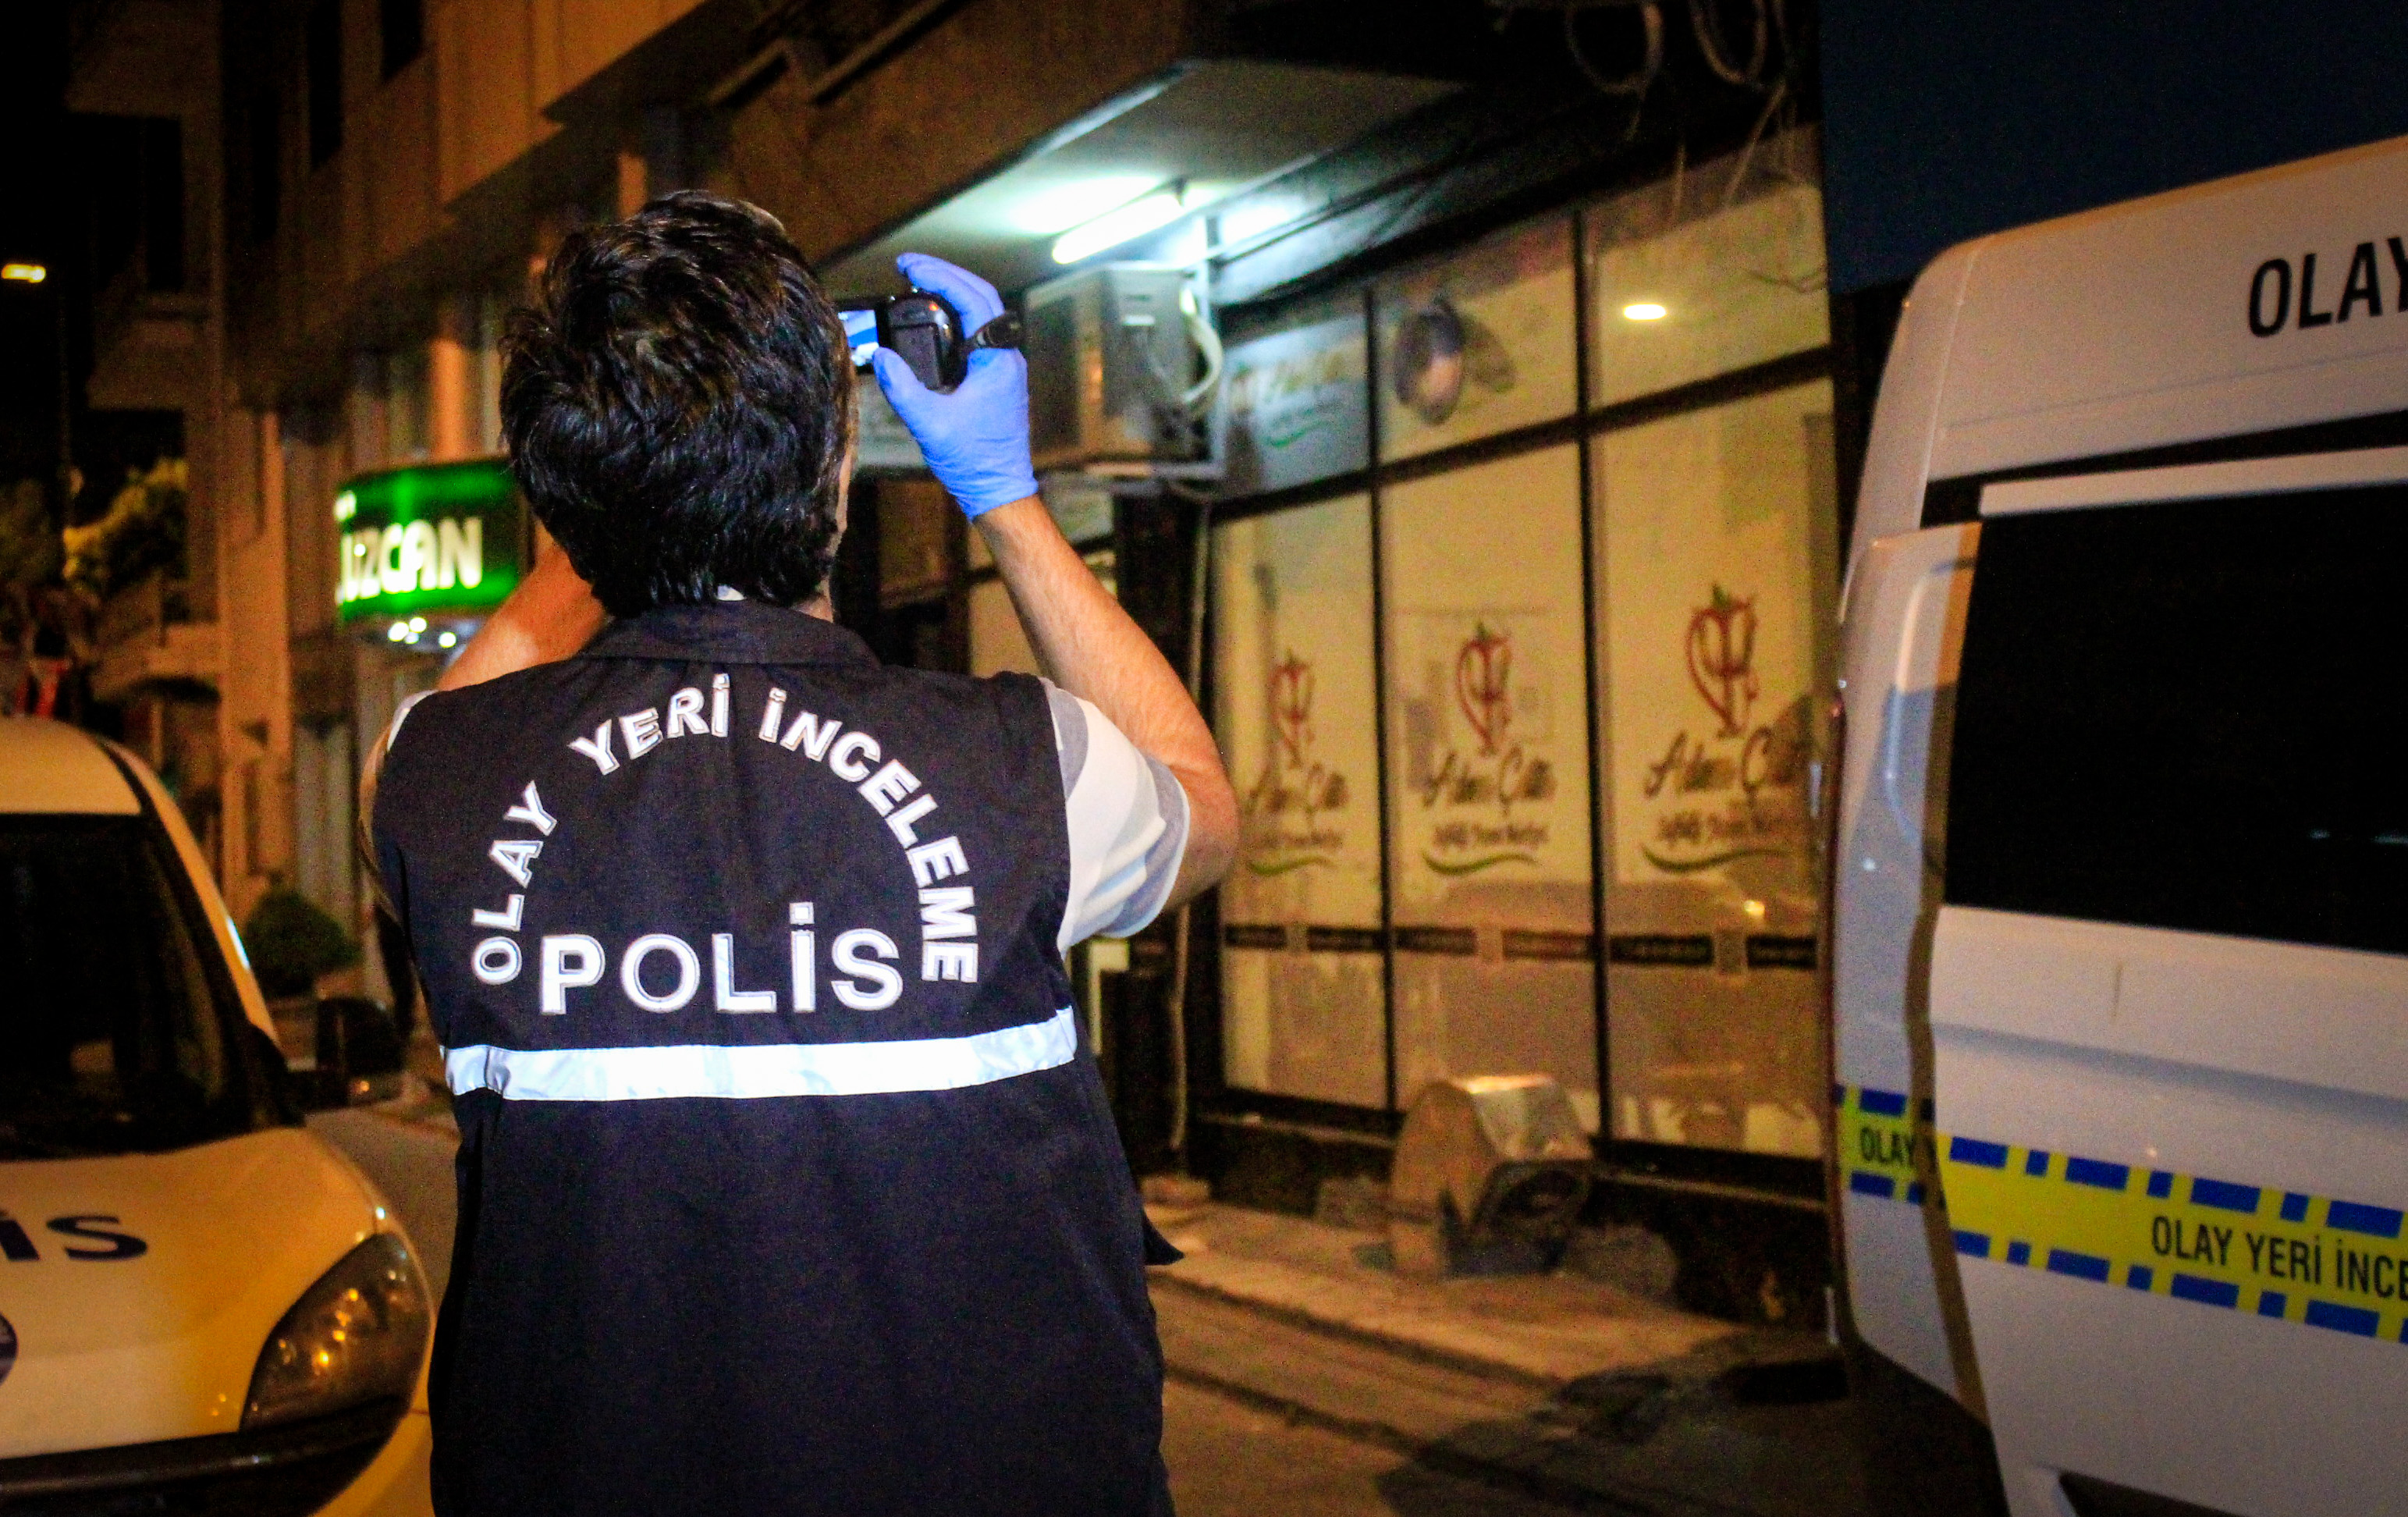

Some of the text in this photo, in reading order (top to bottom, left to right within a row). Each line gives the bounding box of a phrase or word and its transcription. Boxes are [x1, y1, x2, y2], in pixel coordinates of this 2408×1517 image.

[2248, 236, 2408, 338] OLAY
[471, 672, 978, 986] OLAY YERİ İNCELEME
[539, 901, 904, 1015] POLİS
[2151, 1215, 2232, 1267] OLAY
[2246, 1231, 2321, 1285] YERİ
